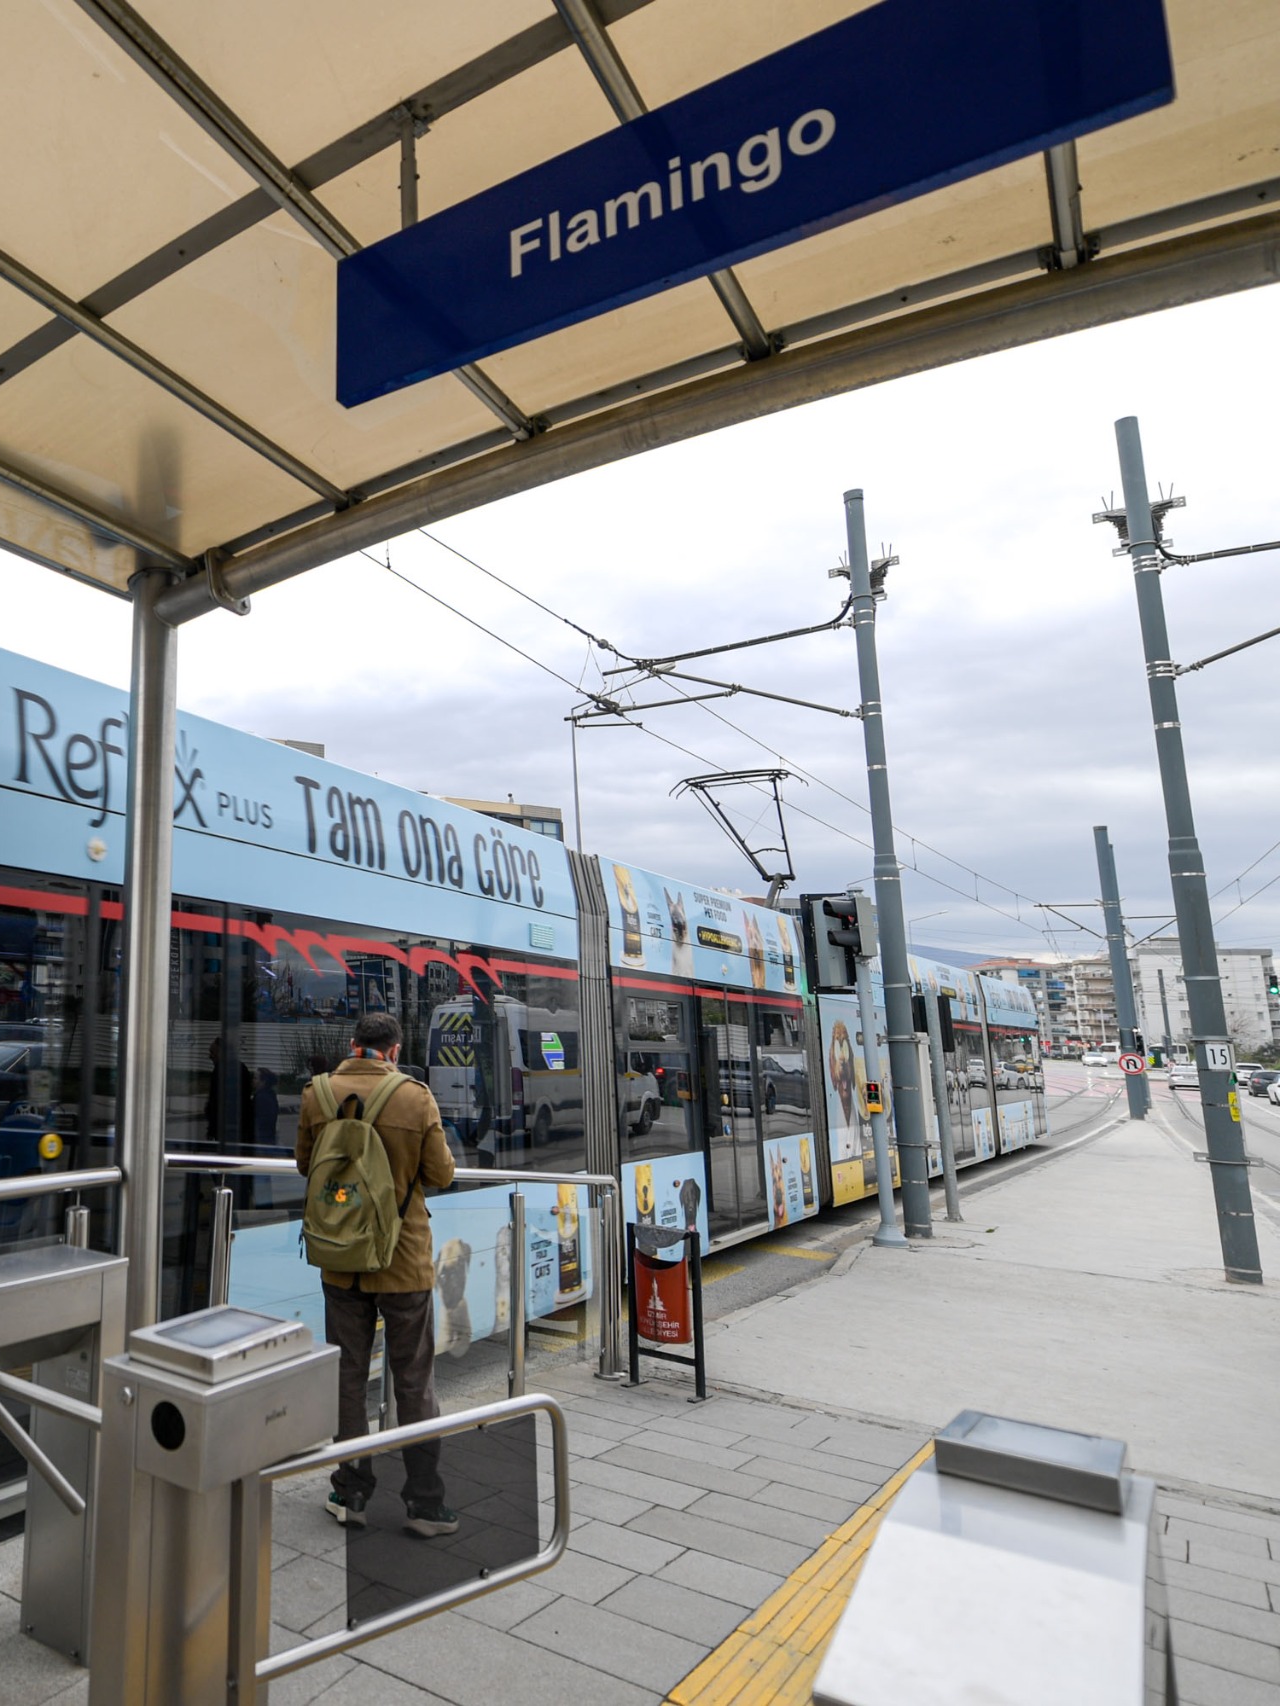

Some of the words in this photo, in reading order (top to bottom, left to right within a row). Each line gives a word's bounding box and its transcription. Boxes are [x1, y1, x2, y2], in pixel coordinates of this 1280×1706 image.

[509, 107, 837, 279] Flamingo
[12, 687, 210, 828] Refx
[217, 791, 273, 829] PLUS
[295, 775, 386, 871] Tam
[399, 809, 463, 890] ona
[1209, 1048, 1227, 1065] 15
[535, 1264, 551, 1279] CATS
